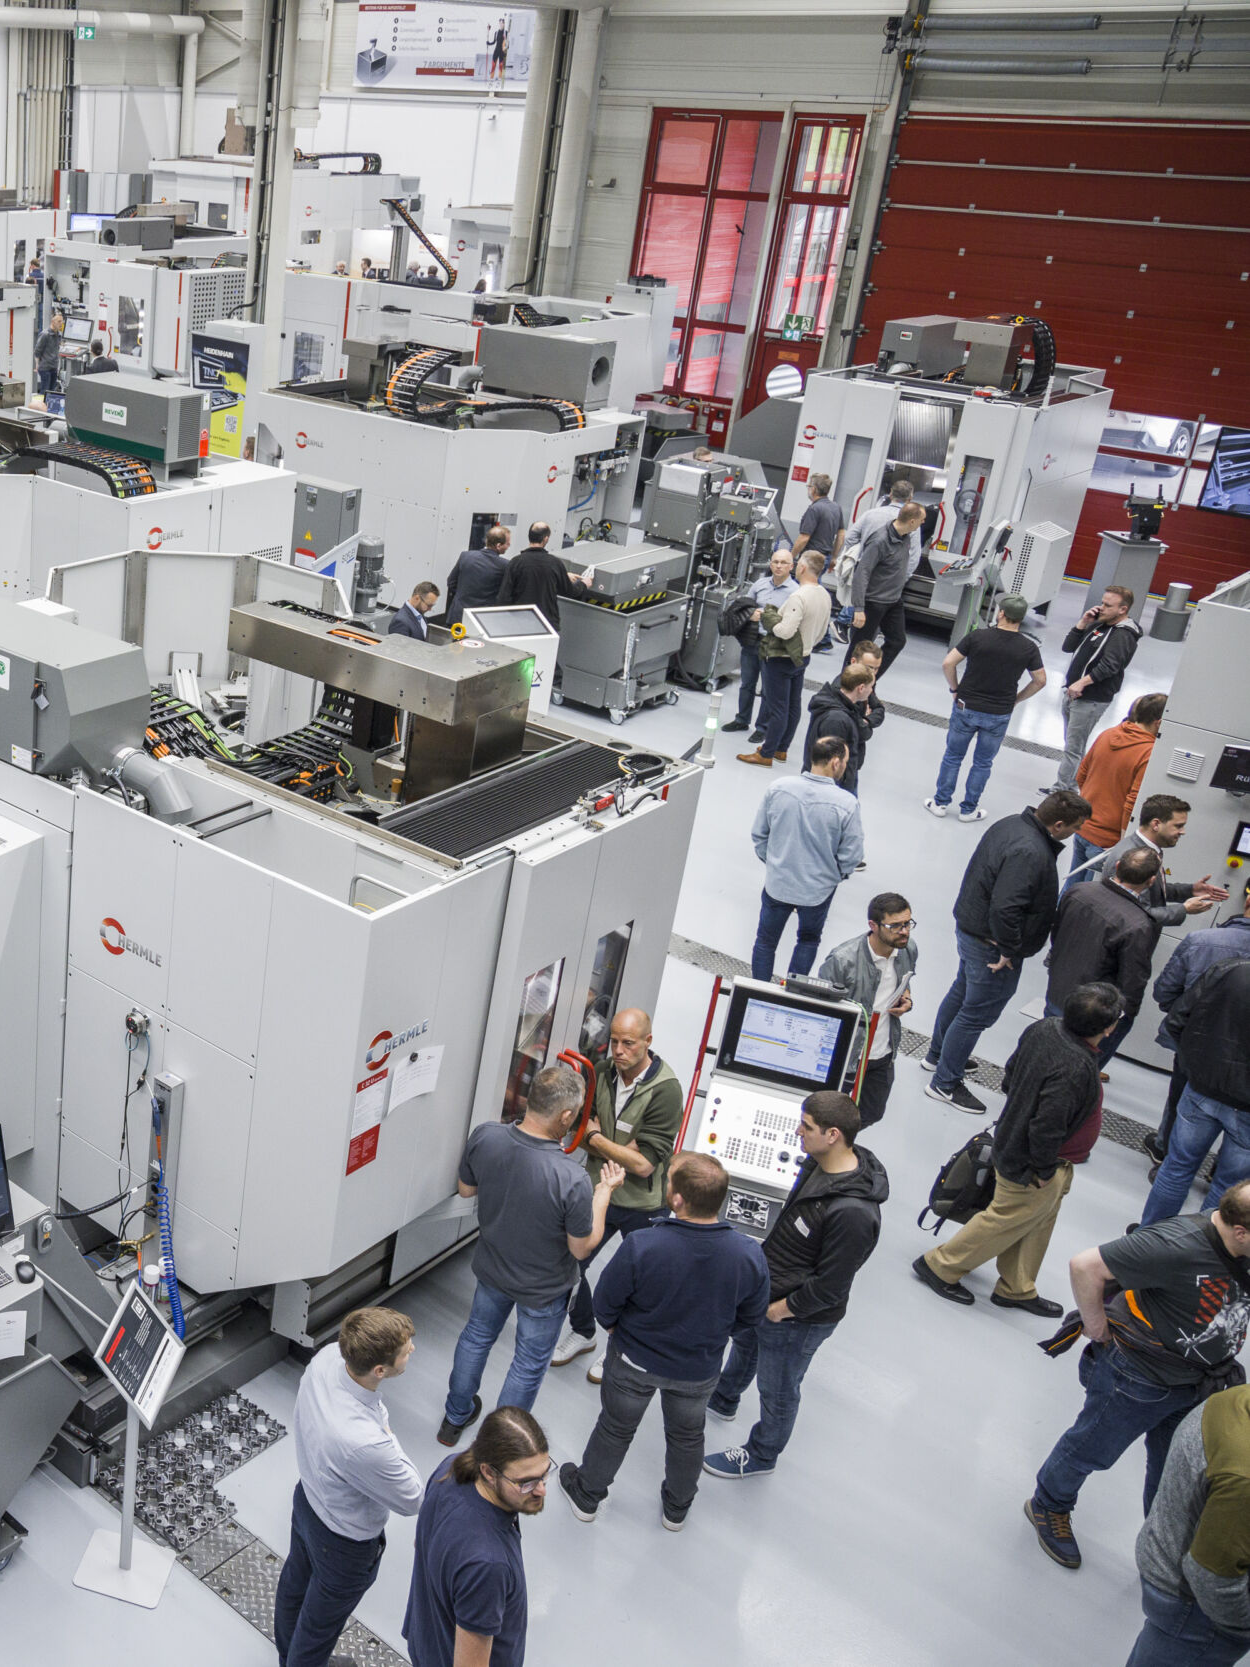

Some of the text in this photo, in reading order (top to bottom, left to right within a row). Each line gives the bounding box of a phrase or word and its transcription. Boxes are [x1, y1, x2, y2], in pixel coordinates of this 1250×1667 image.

[203, 347, 234, 359] HEIDENHAIN
[1235, 773, 1250, 783] Rü
[118, 934, 162, 968] HERMLE
[384, 1018, 429, 1053] HERMLE
